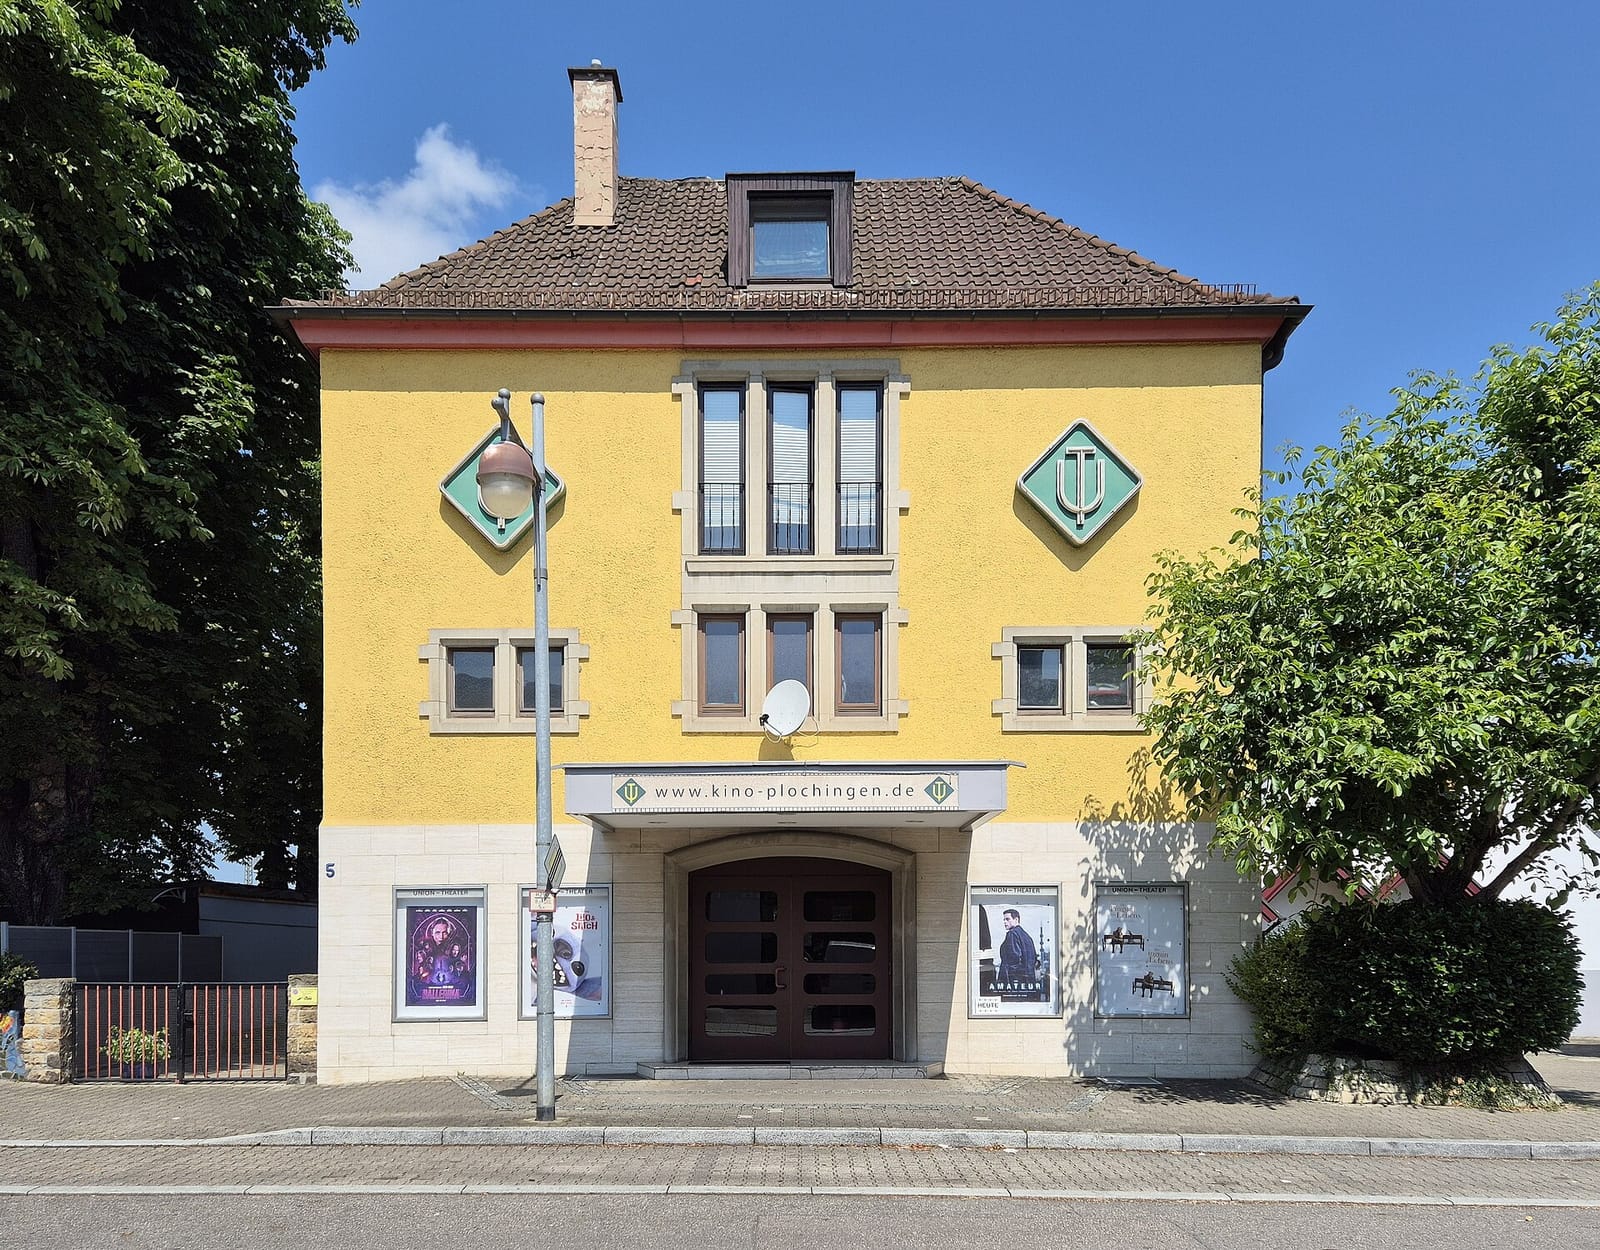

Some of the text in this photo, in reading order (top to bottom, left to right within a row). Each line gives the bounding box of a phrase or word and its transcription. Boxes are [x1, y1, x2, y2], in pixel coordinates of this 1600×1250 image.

[655, 784, 915, 800] www.kino-plochingen.de
[325, 862, 336, 878] 5
[989, 982, 1041, 990] AMATEUR
